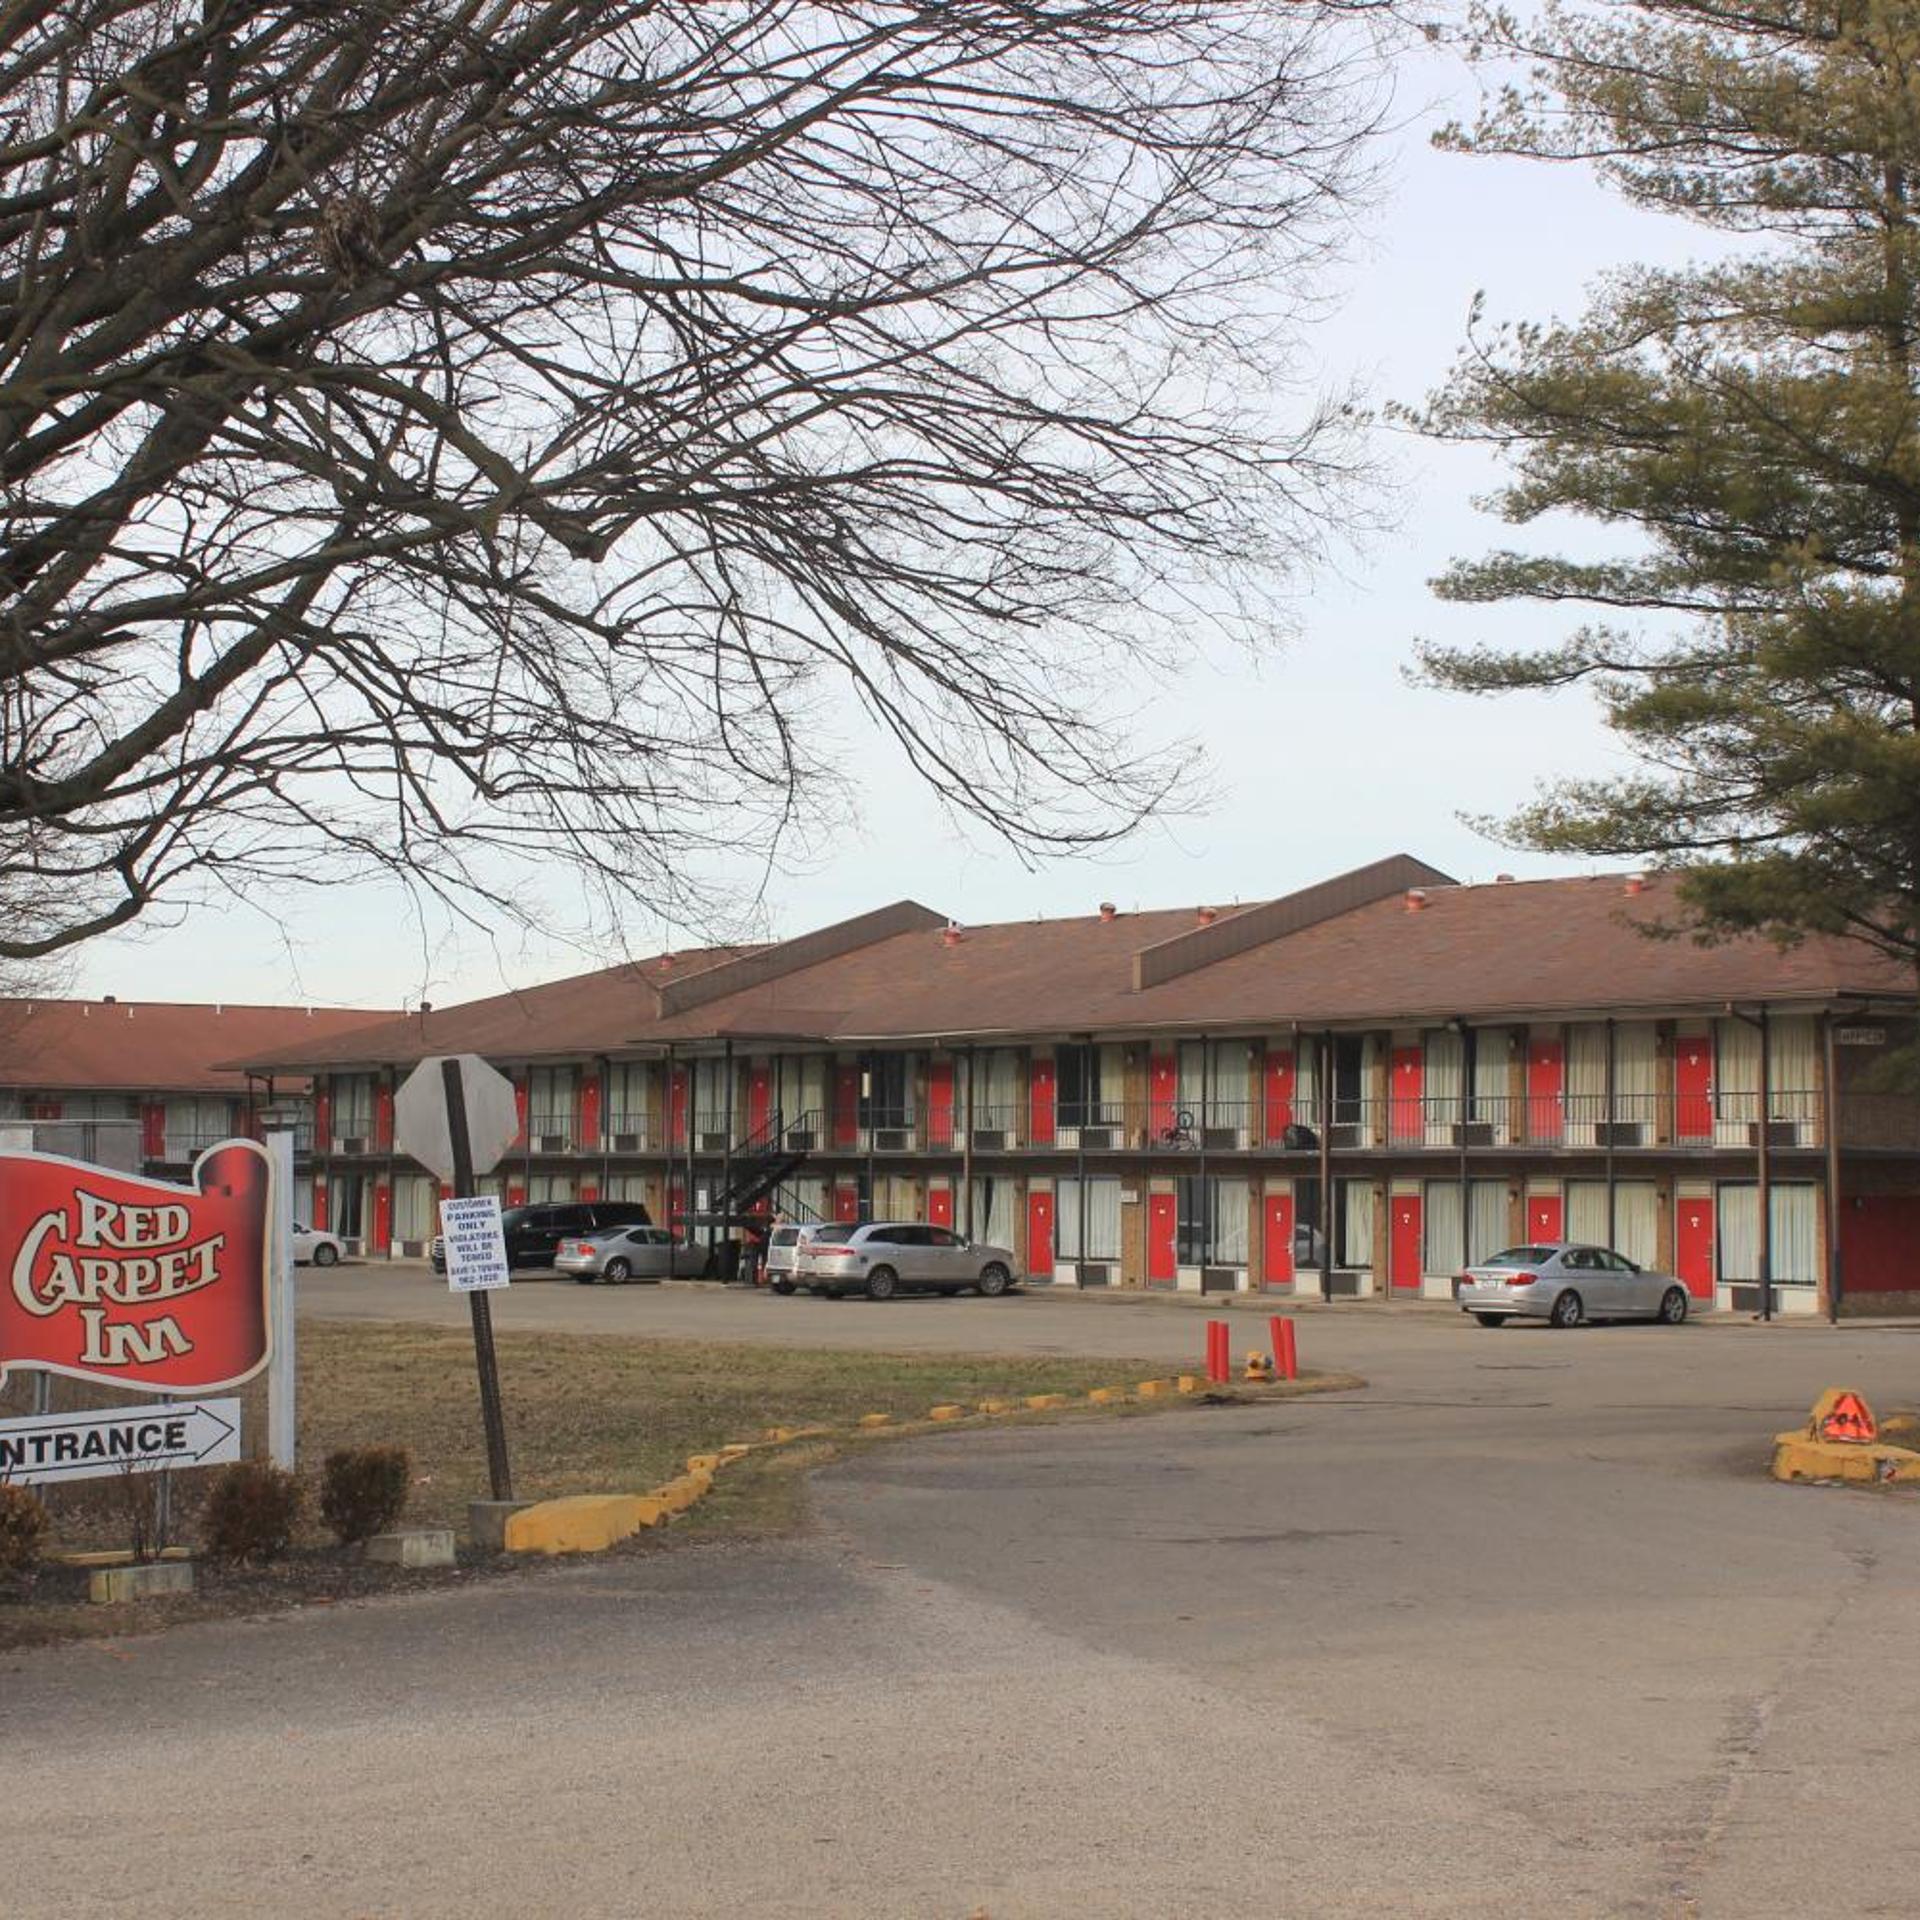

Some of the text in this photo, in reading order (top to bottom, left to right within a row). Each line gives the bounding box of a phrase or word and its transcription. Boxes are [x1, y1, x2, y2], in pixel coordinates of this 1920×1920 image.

[74, 1188, 191, 1249] RED
[447, 1209, 496, 1221] PARKING
[458, 1221, 486, 1231] ONLY
[449, 1231, 499, 1243] VIOLATORS
[457, 1243, 478, 1252] WILL
[12, 1209, 225, 1316] CARPET
[461, 1252, 493, 1262] TOWED
